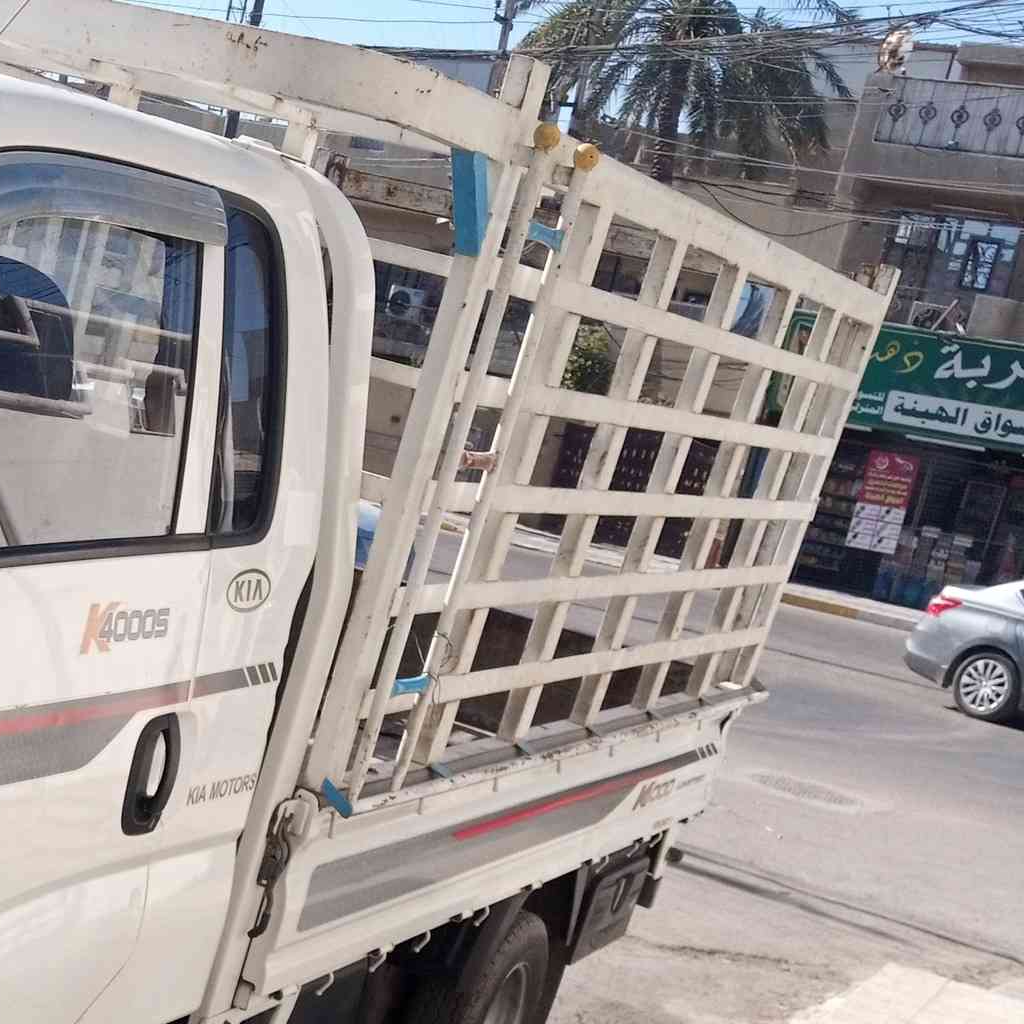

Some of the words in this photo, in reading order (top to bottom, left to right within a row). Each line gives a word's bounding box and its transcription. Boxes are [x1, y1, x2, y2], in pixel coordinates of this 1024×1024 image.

[233, 578, 263, 603] KIA
[80, 601, 170, 655] K4000S
[186, 784, 207, 806] KIA
[209, 772, 257, 800] MOTORS
